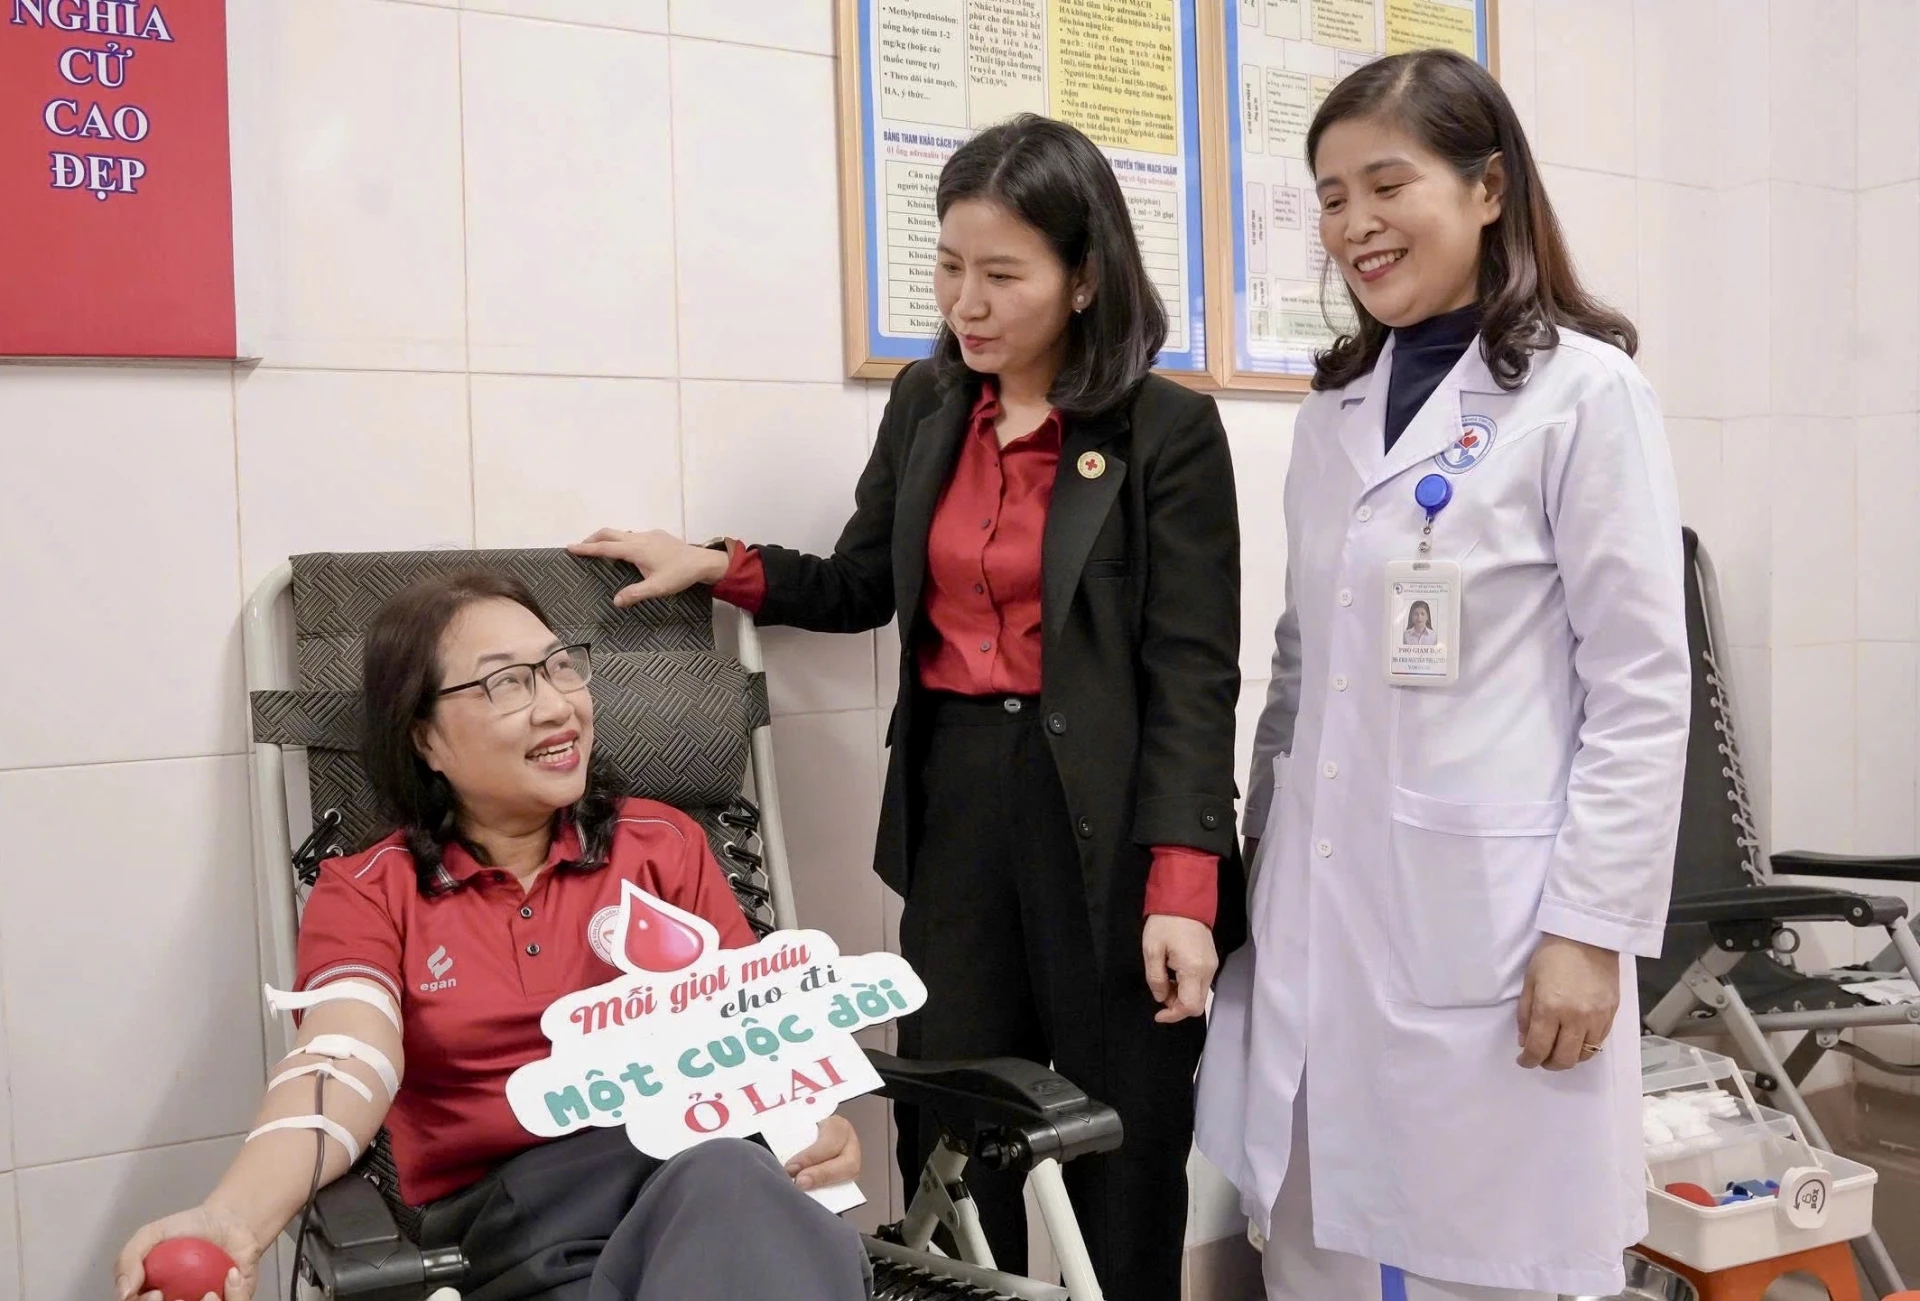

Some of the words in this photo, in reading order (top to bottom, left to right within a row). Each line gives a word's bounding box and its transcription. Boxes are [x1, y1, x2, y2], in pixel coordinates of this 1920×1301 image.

[969, 12, 985, 21] phút
[988, 15, 1000, 23] cho
[1017, 20, 1027, 28] khi
[993, 5, 1002, 14] lại
[1030, 11, 1040, 19] 3-5
[903, 25, 919, 35] hoặc
[922, 27, 937, 37] tiêm
[940, 30, 950, 39] 1-2
[969, 23, 980, 31] các
[883, 40, 906, 50] mg/kg
[908, 42, 927, 53] (hoặc
[929, 45, 941, 54] các
[58, 41, 134, 87] CỬ
[883, 54, 904, 64] thuốc
[906, 59, 928, 69] tương
[929, 62, 940, 71] tự)
[890, 72, 908, 81] Theo
[43, 99, 149, 141] CAO
[884, 128, 900, 142] BẢNG
[902, 132, 918, 144] THAM
[919, 133, 935, 146] KHẢO
[936, 136, 952, 149] CÁCH
[49, 151, 146, 200] ĐẸP
[908, 170, 923, 179] Cân
[897, 183, 919, 191] người
[420, 978, 457, 992] egan
[570, 986, 658, 1035] Mỗi
[670, 964, 730, 1014] giọt
[741, 944, 811, 984] máu
[720, 983, 786, 1019] cho
[800, 964, 843, 993] đi
[543, 1061, 663, 1127] Một
[678, 1014, 814, 1078] cuộc
[827, 978, 908, 1029] đời
[684, 1092, 730, 1134] Ở
[737, 1055, 848, 1117] LẠI
[1811, 1189, 1819, 1208] BOX
